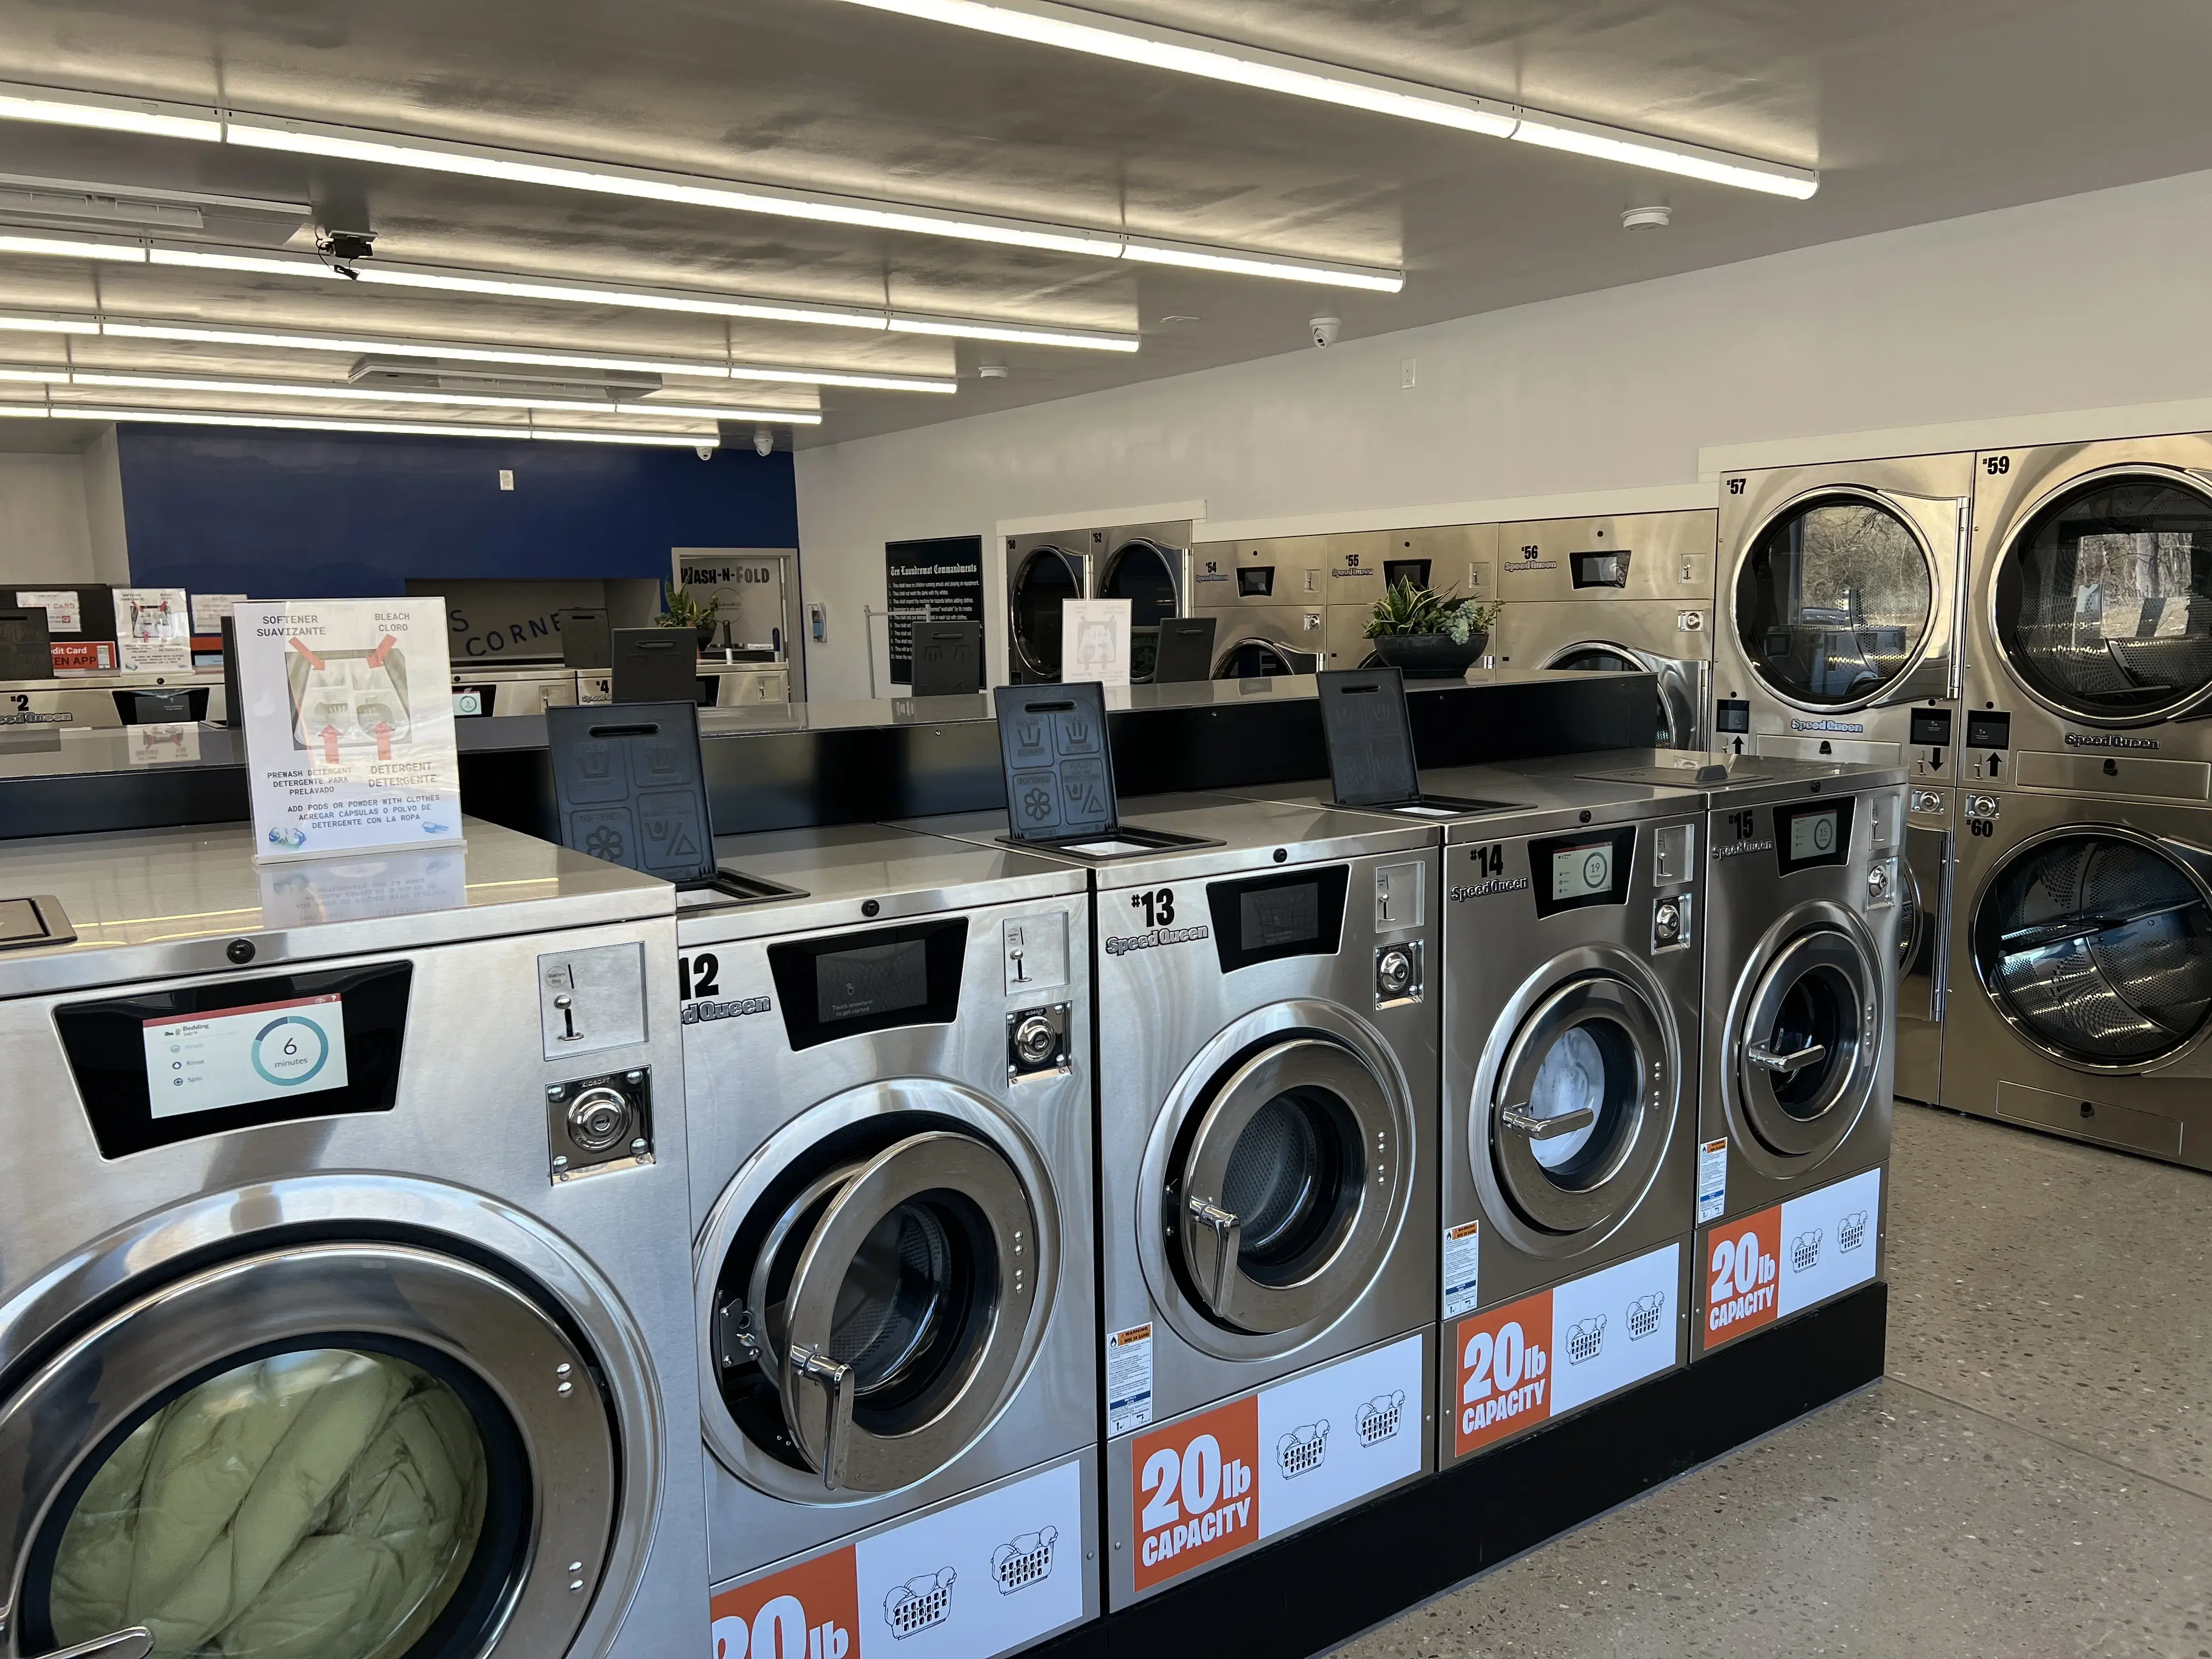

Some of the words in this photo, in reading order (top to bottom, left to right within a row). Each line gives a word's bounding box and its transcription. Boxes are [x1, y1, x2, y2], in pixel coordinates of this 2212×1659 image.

[1982, 456, 2010, 474] #59
[1726, 478, 1746, 495] #57
[1521, 545, 1538, 559] #56
[891, 566, 900, 575] Ten
[901, 565, 932, 575] Laundromat
[934, 563, 977, 574] Commandments
[263, 614, 318, 624] SOFTENER
[375, 612, 410, 621] BLEACH
[257, 627, 326, 637] SUAVIZANTE
[466, 613, 561, 656] CORNE
[74, 657, 97, 665] APP
[10, 695, 29, 712] #2
[0, 713, 25, 725] eed
[25, 712, 72, 723] Queen
[1791, 719, 1827, 731] Speed
[1826, 720, 1863, 733] Queen
[2064, 732, 2112, 747] Speed
[2112, 734, 2160, 749] Queen
[267, 770, 303, 778] PREWASH
[308, 767, 352, 776] DETERGENT
[371, 762, 432, 774] DETERGENT
[273, 778, 324, 788] DETERGENTE
[368, 775, 437, 787] DETERGENTE
[289, 786, 334, 795] PRELAVADO
[348, 799, 378, 808] POWDER
[407, 794, 440, 803] CLOTHES
[299, 812, 334, 821] AGREGAR
[339, 808, 379, 817] CÁPSULAS
[312, 819, 363, 829] DETERGENTE
[1729, 810, 1753, 839] #15
[1966, 819, 1993, 838] #60
[1470, 844, 1504, 878] #14
[1591, 862, 1600, 873] 19
[1451, 881, 1491, 902] Speed
[1490, 877, 1528, 894] Queen
[1131, 888, 1175, 928] #13
[1105, 930, 1158, 956] Speed
[1158, 926, 1209, 945] Queen
[679, 953, 719, 1001] 12
[699, 996, 771, 1021] Queen
[284, 1037, 297, 1055] 6
[275, 1057, 308, 1068] minutes
[1709, 1284, 1775, 1331] CAPACITY
[1125, 1327, 1148, 1336] WARNING
[1463, 1379, 1546, 1435] CAPACITY
[1142, 1497, 1251, 1567] CAPACITY
